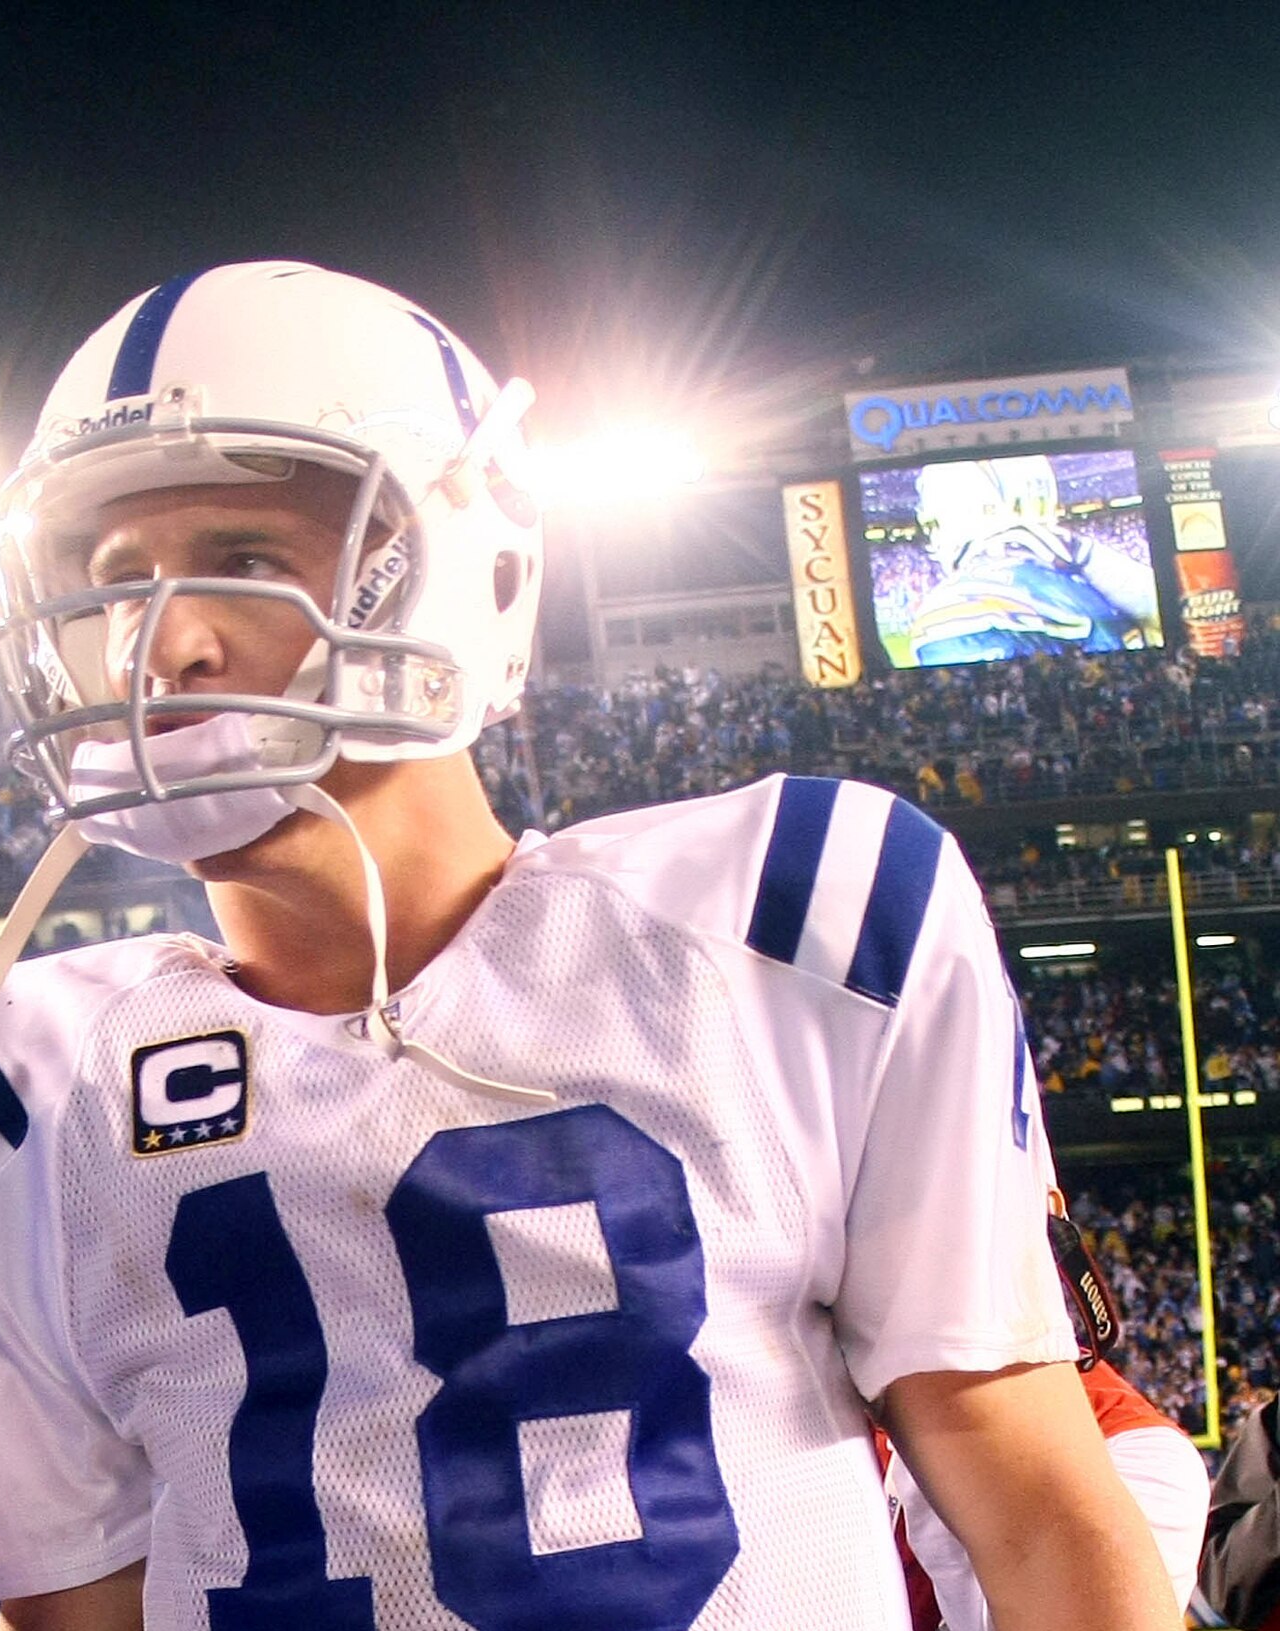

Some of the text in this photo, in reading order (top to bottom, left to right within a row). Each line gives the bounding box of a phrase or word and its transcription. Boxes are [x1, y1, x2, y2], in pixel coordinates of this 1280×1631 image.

[79, 402, 155, 435] Riddel
[849, 382, 1131, 453] QUALCOMM
[799, 493, 850, 681] SYCUAN
[1182, 600, 1240, 619] LIGHT
[1187, 589, 1235, 607] BUD
[139, 1040, 242, 1127] C
[1080, 1270, 1112, 1341] Canon
